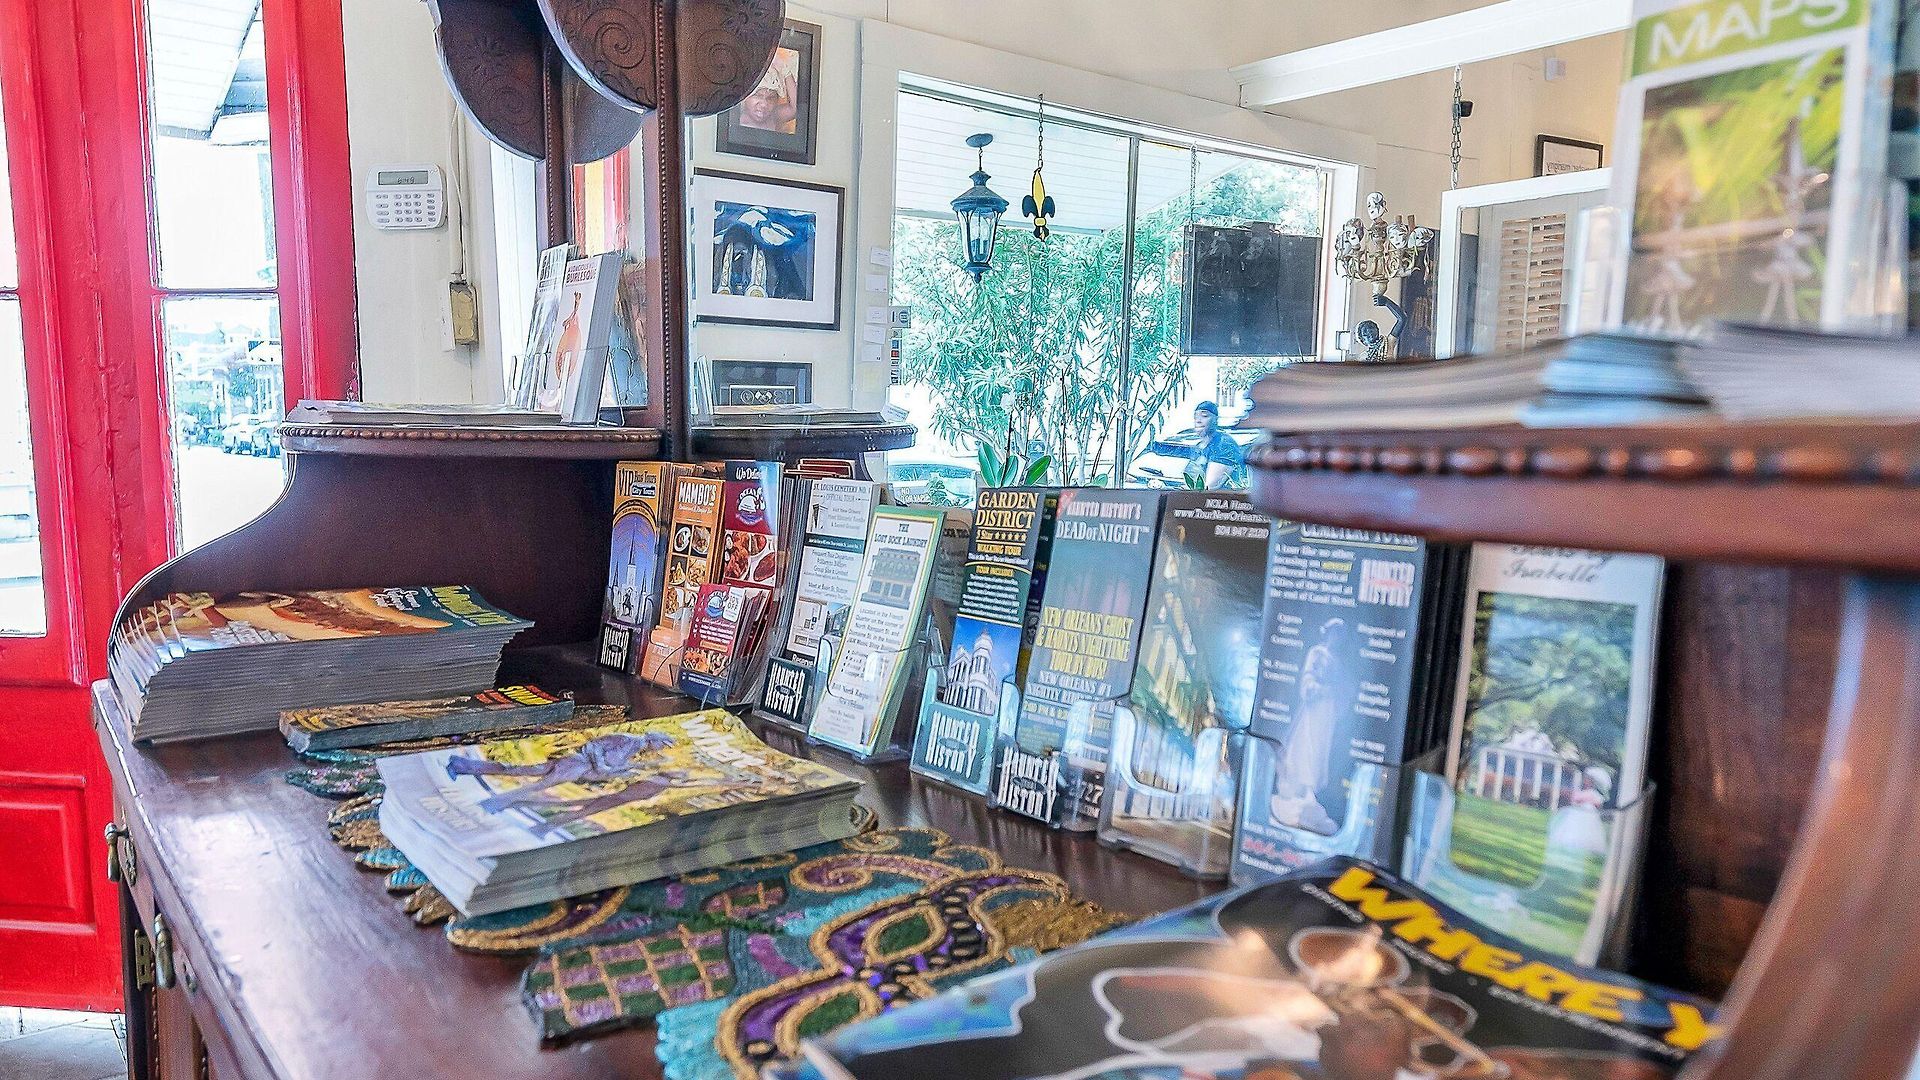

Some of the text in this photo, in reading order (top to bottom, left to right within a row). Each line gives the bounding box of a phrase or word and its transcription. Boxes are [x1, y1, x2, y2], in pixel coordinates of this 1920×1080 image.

[1650, 0, 1849, 64] MAPS
[619, 468, 633, 496] VIP
[678, 481, 717, 506] MAMBO'S
[978, 491, 1039, 509] GARDEN
[1205, 498, 1229, 509] NOLA
[975, 509, 1036, 529] DISTRICT
[1055, 520, 1087, 540] DEAD
[602, 627, 630, 650] HAUNTED
[600, 645, 628, 671] HISTORY
[768, 661, 807, 695] HAUNTED
[764, 685, 804, 720] HISTORY
[931, 710, 980, 750] HAUNTED
[924, 740, 977, 779] HISTORY
[1002, 745, 1060, 792] HAUNTED
[999, 778, 1059, 823] HISTORY
[1327, 867, 1644, 1023] WHERE
